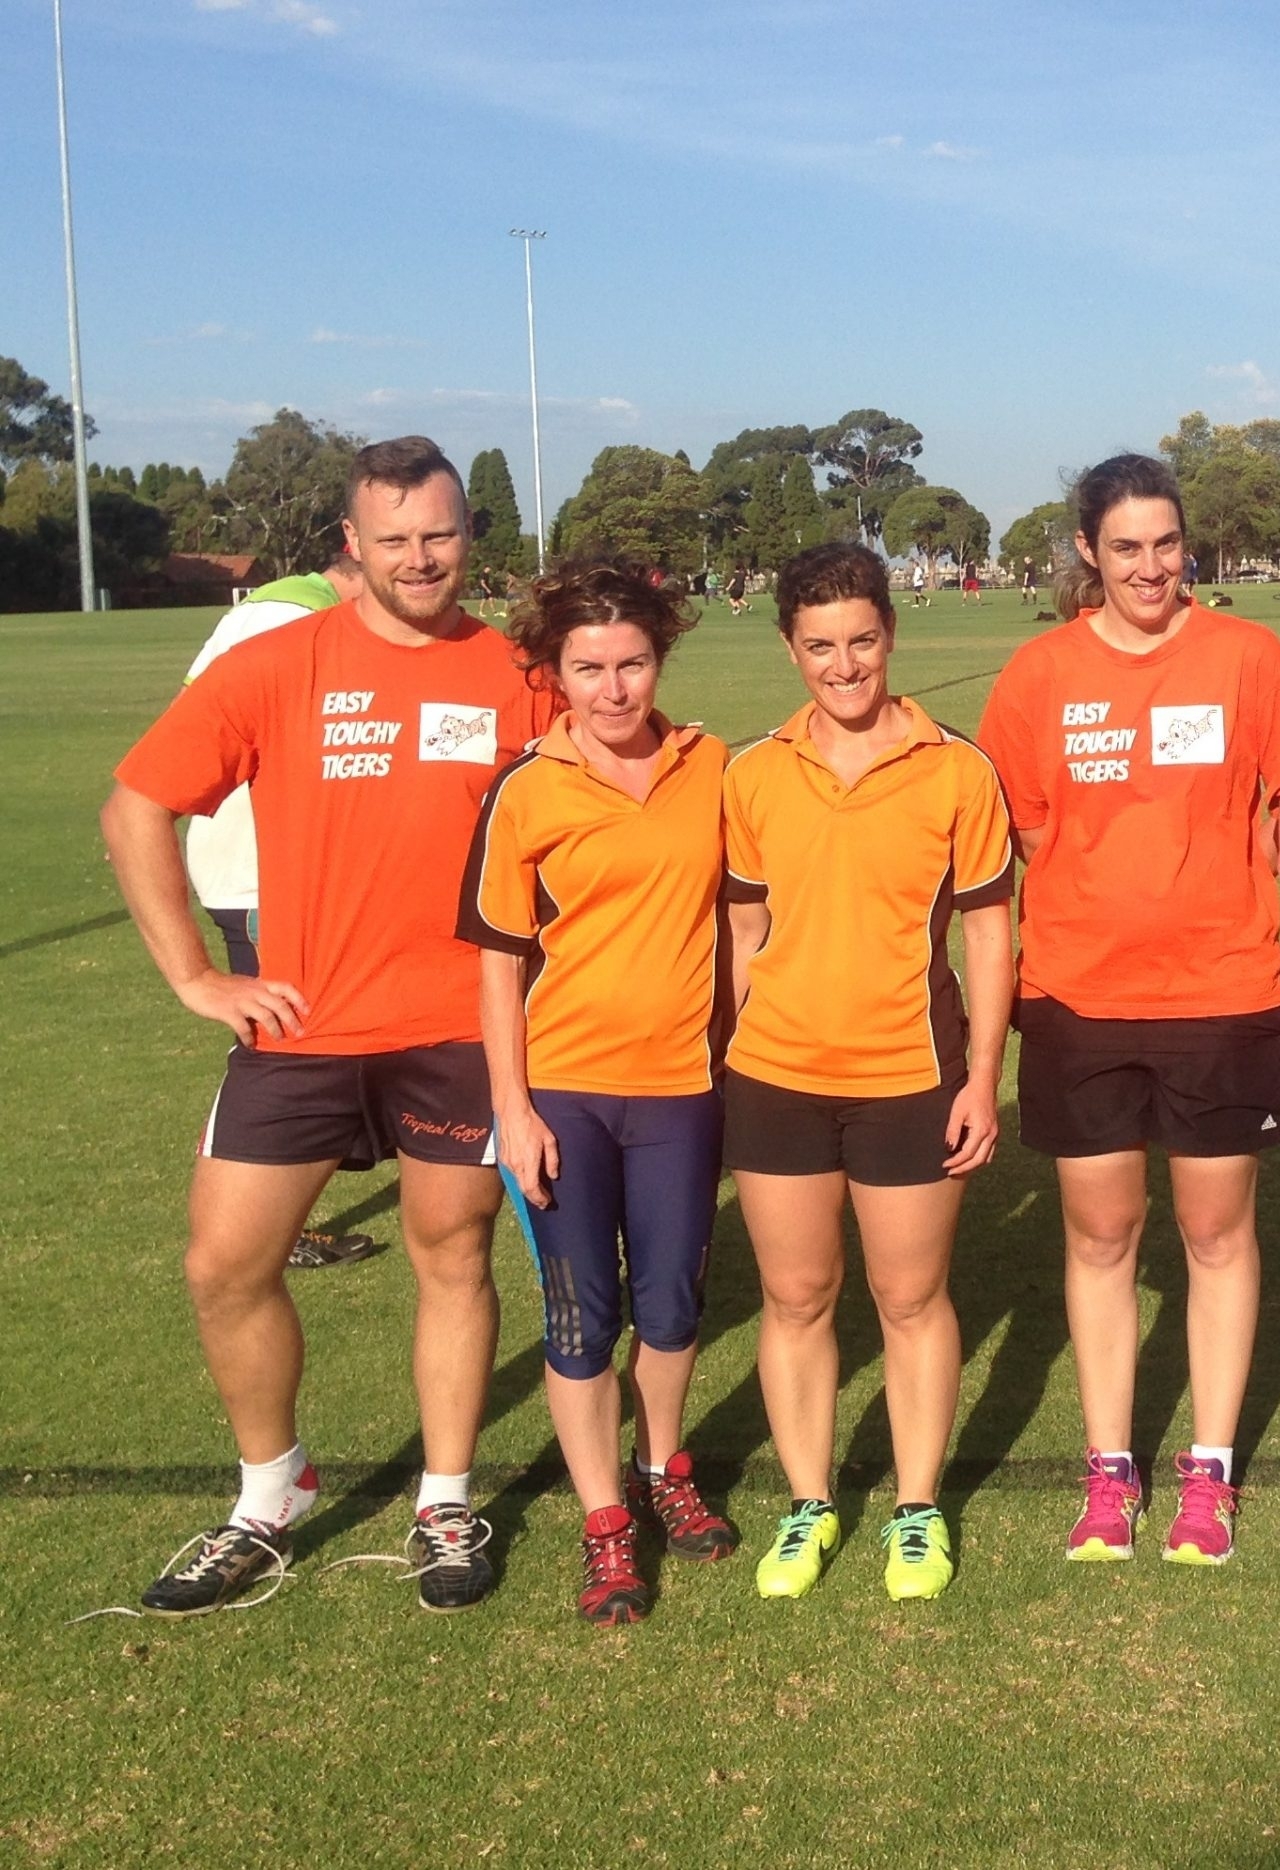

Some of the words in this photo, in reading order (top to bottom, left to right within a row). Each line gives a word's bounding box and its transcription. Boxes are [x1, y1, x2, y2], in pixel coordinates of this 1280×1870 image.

[322, 691, 375, 715] EASY
[1062, 702, 1111, 726] EASY
[323, 721, 402, 747] TOUCHY
[1064, 729, 1137, 755] TOUCHY
[322, 753, 392, 780] TIGERS
[1067, 759, 1130, 783] TIGERS
[401, 1112, 452, 1136] Tropical
